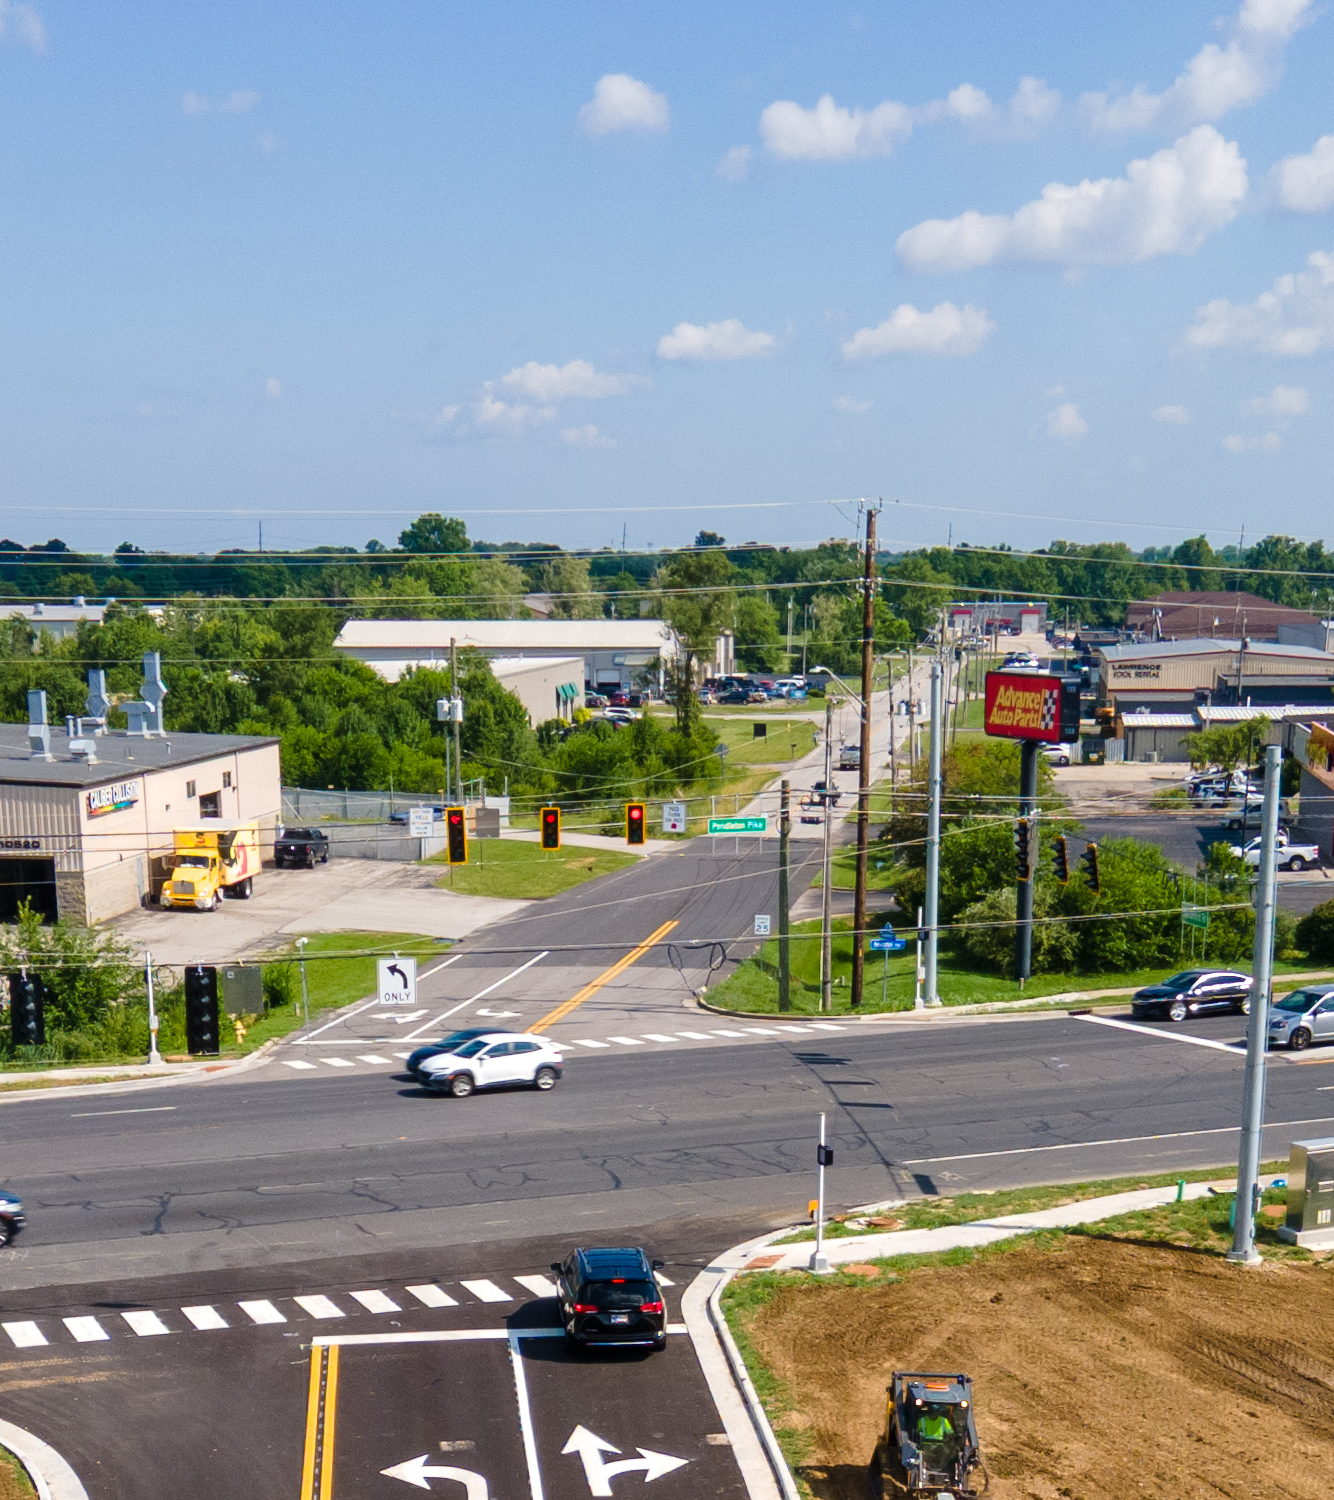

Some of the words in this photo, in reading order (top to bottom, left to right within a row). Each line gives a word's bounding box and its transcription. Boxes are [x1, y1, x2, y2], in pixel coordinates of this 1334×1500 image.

[995, 685, 1041, 711] Advance
[988, 707, 1014, 726] Auto
[384, 992, 411, 1001] ONLY
